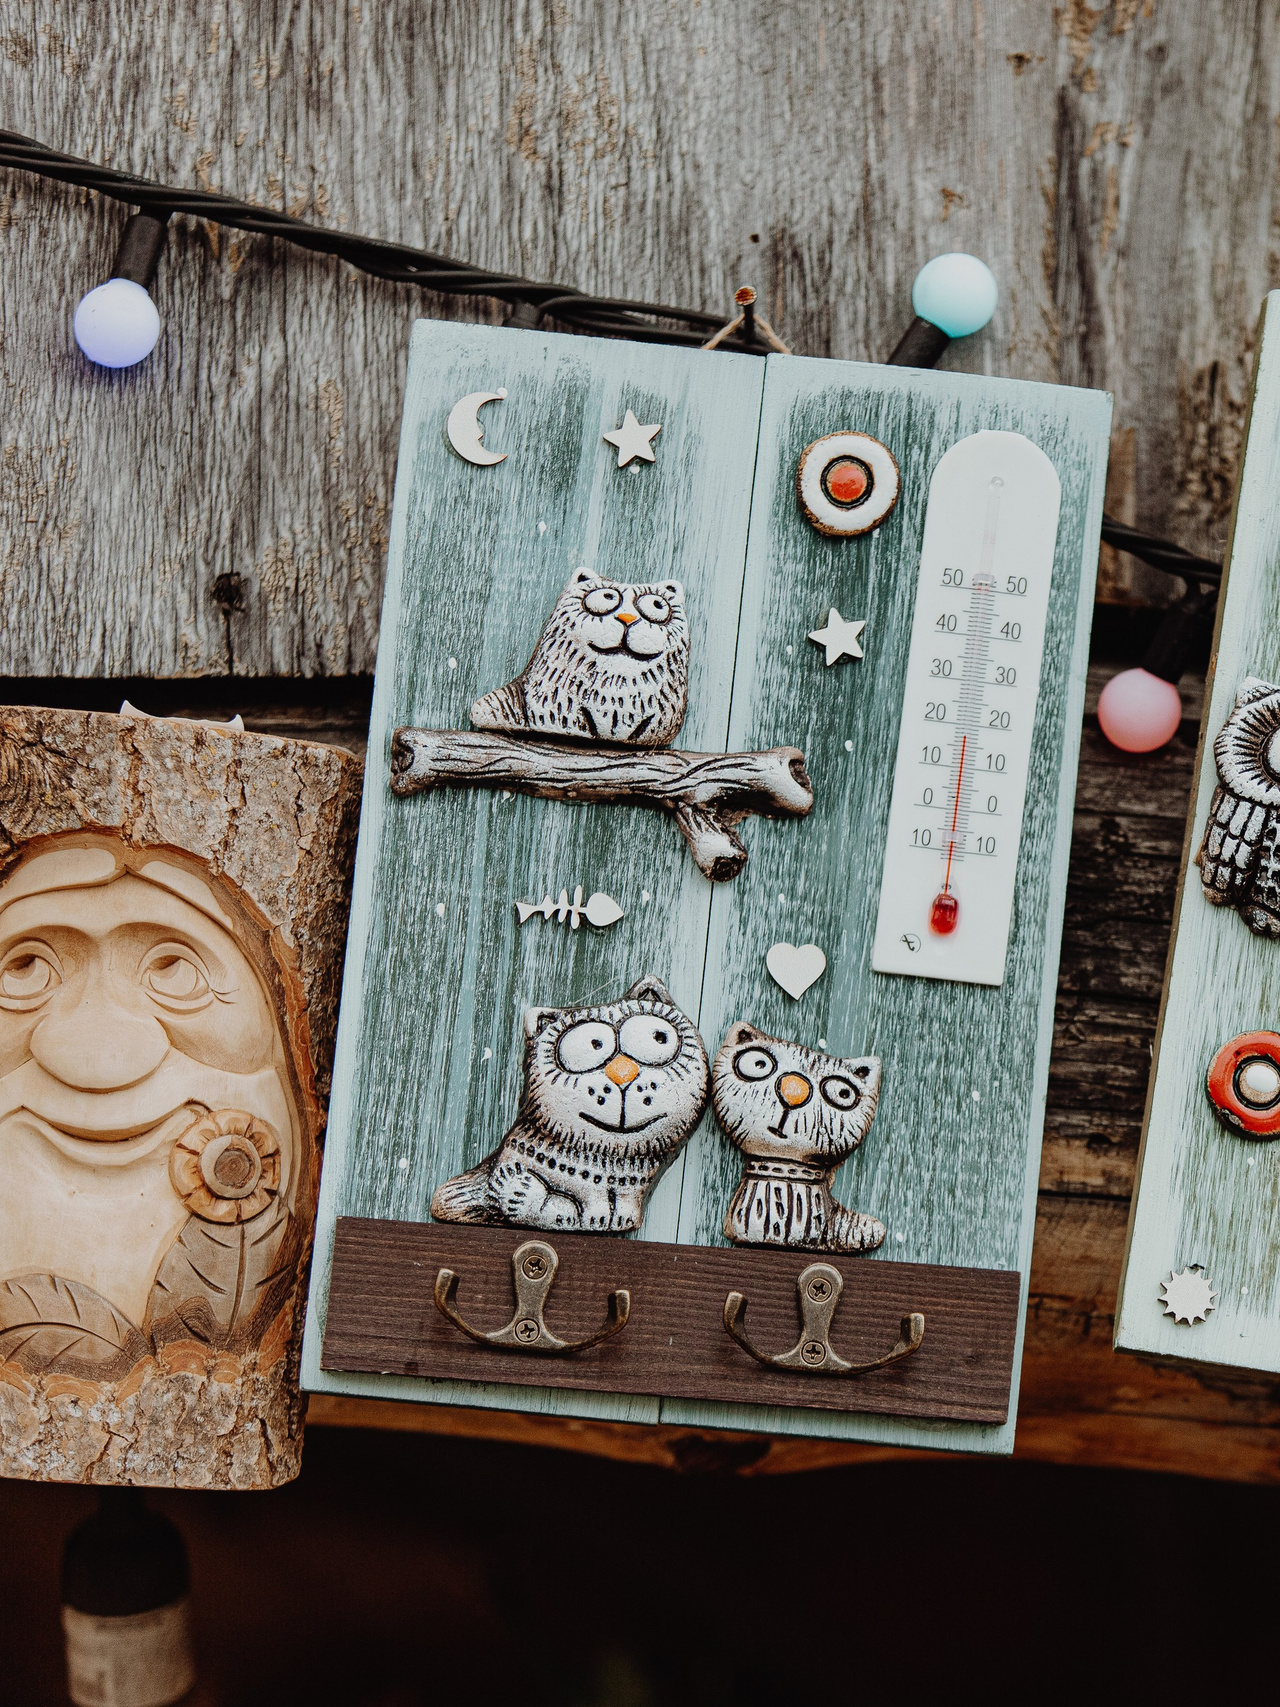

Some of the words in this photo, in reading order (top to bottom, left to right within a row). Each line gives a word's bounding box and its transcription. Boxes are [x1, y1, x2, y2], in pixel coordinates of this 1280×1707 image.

[941, 567, 964, 587] 50
[1005, 575, 1028, 595] 50
[935, 613, 958, 632] 40
[1000, 621, 1022, 640] 40
[930, 658, 953, 677] 30
[994, 666, 1017, 685] 30
[924, 701, 947, 721] 20
[988, 709, 1011, 729] 20
[921, 745, 942, 764] 10
[986, 753, 1006, 772] 10
[922, 787, 934, 806] 0
[987, 795, 998, 813] 0
[912, 828, 932, 847] 10
[976, 836, 996, 854] 10
